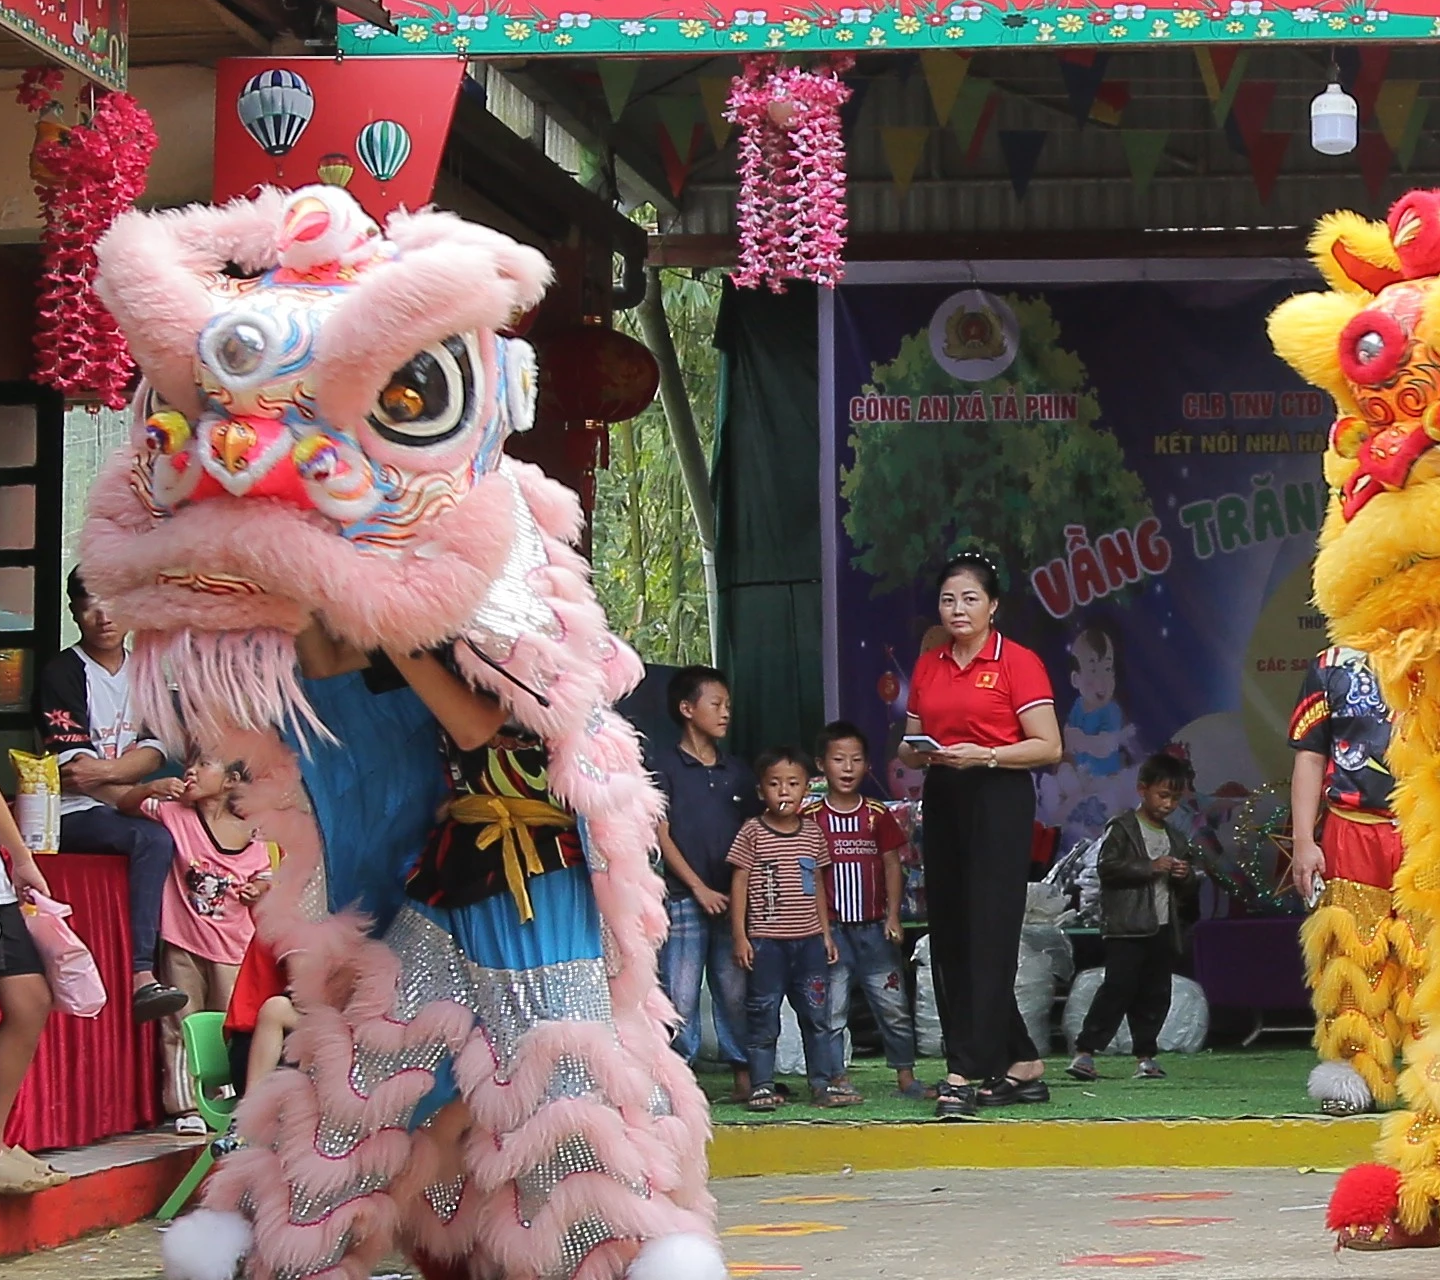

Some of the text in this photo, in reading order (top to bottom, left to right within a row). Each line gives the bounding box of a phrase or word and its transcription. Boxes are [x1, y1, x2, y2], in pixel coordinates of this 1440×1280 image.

[849, 390, 912, 423] CÔNG
[915, 395, 950, 423] AN
[954, 389, 987, 422] XÃ
[990, 386, 1021, 421] TẢ
[1182, 391, 1226, 419] CLB
[1230, 390, 1276, 419] TNV
[1154, 428, 1193, 454] KẾT
[1030, 472, 1332, 620] VẦNG TRĂN
